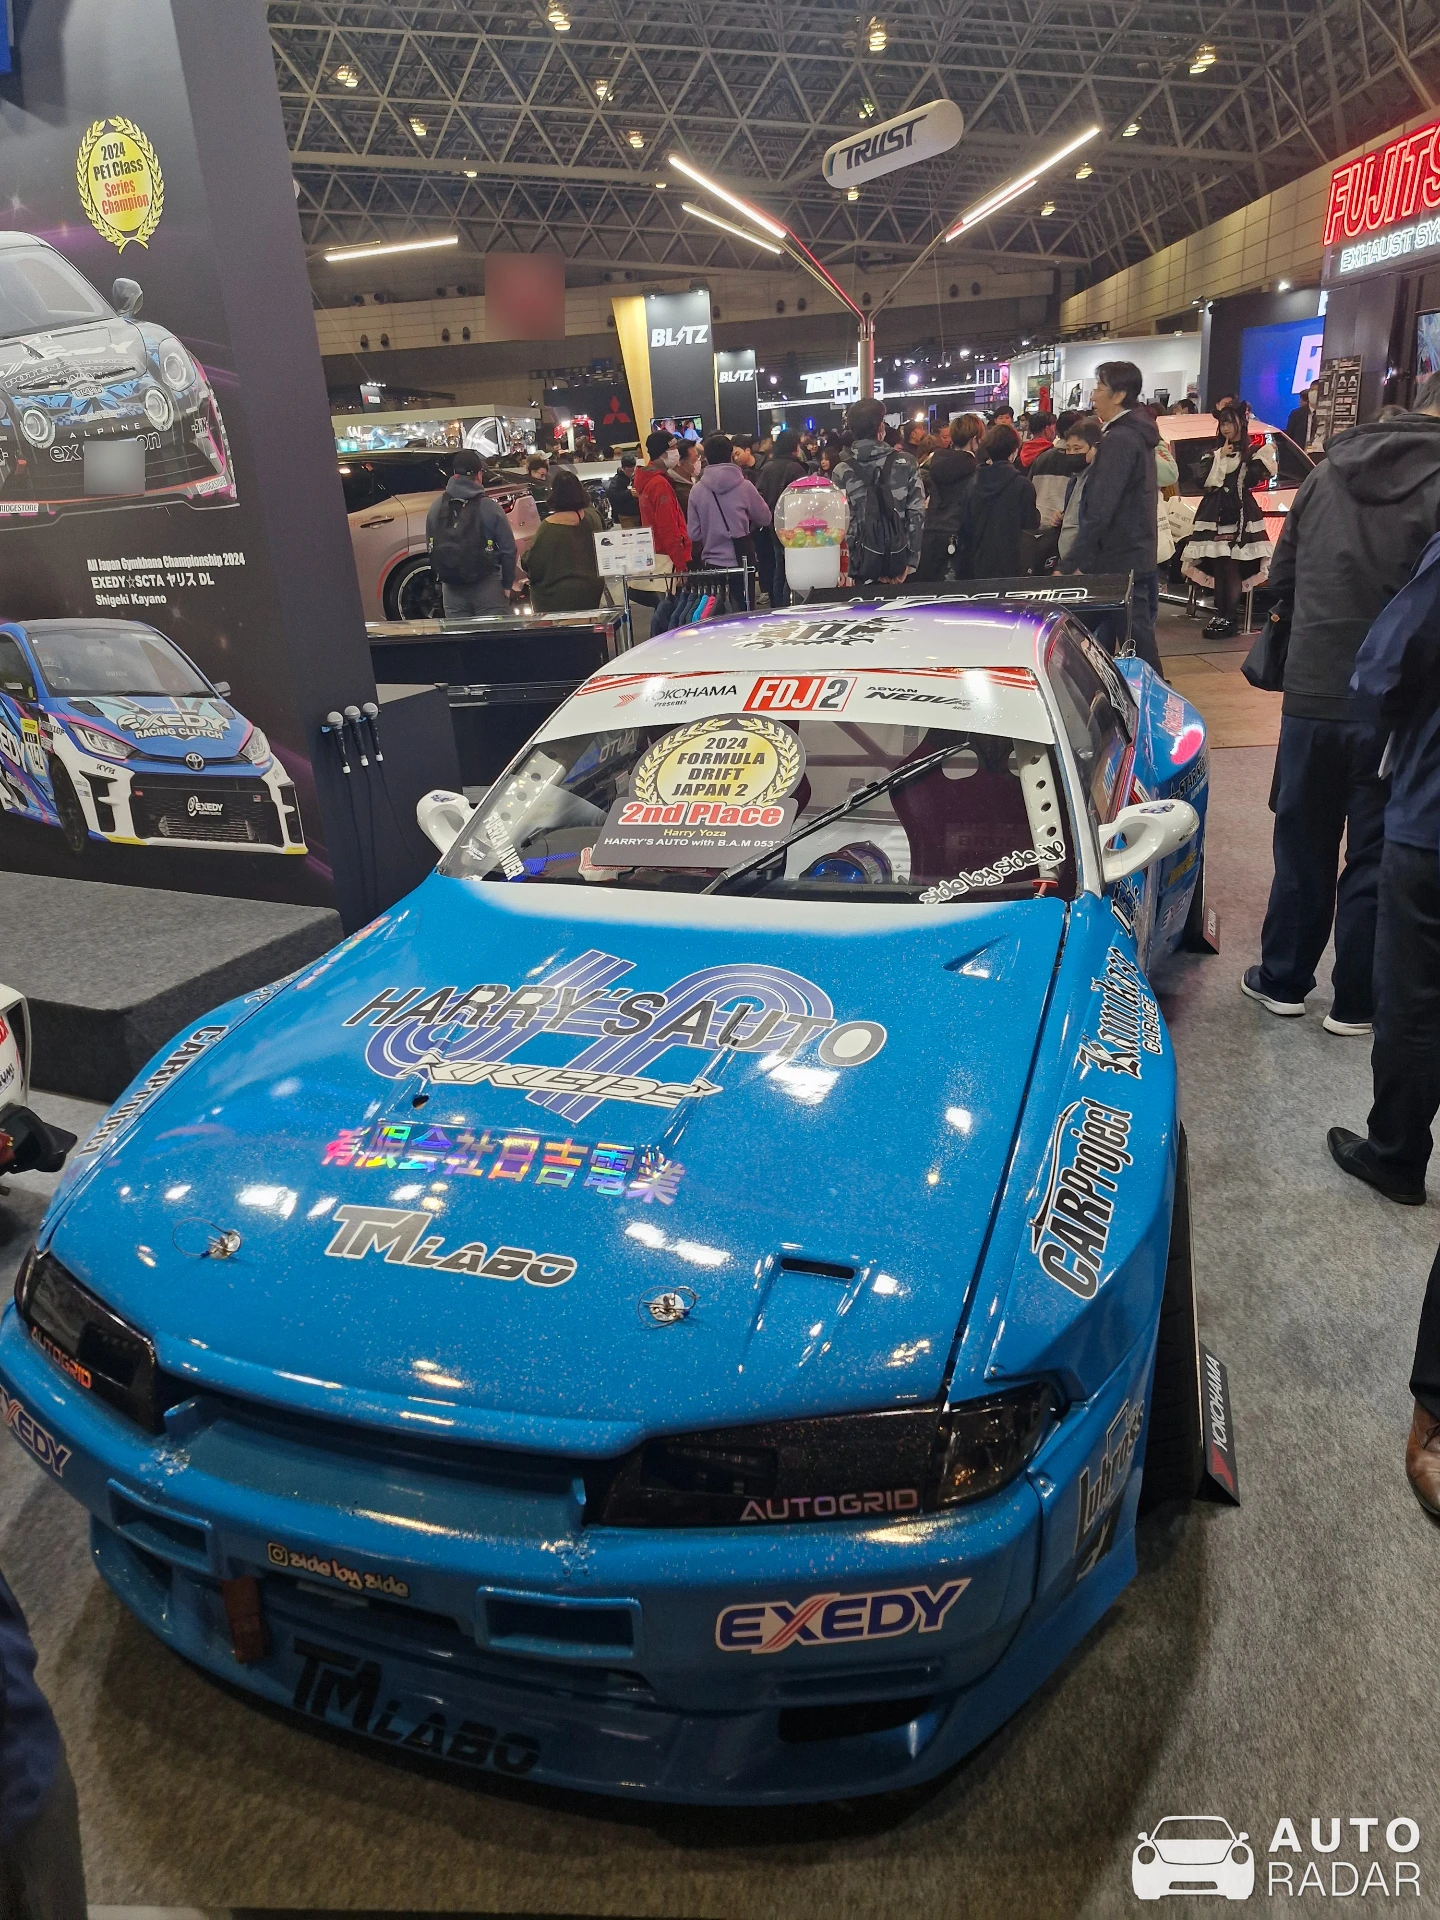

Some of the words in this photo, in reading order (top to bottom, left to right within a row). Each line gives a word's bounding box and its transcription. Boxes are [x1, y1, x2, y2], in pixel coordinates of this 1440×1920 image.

[839, 114, 928, 168] TRUST
[101, 142, 126, 161] 2024
[93, 164, 112, 181] PE1
[112, 159, 144, 177] Class
[104, 180, 136, 198] Series
[101, 194, 149, 215] Champion
[1340, 227, 1416, 273] EXHAUST
[651, 325, 708, 348] BLITZ
[719, 369, 754, 383] BLITZ
[70, 422, 141, 438] ALPINE
[87, 559, 98, 571] All
[99, 558, 121, 571] Japan
[121, 557, 163, 570] Gymkhana
[163, 554, 223, 568] Championship
[223, 552, 245, 566] 2024
[166, 572, 197, 587] ヤリス
[198, 572, 215, 586] DL
[95, 594, 130, 607] Shigeki
[131, 593, 167, 606] Kayano
[654, 700, 688, 708] Presents
[117, 713, 228, 732] EXEDY
[135, 727, 179, 739] RACING
[179, 727, 224, 740] CLUTCH
[704, 737, 749, 750] 2024
[677, 752, 766, 765] FORMULA
[688, 767, 745, 780] DRIFT
[672, 783, 732, 797] JAPAN
[735, 783, 749, 797] 2
[195, 801, 223, 812] EXEDY
[619, 802, 688, 825] 2nd
[687, 802, 784, 827] Place
[483, 811, 511, 850] FUERZA
[663, 828, 696, 838] Harry
[700, 829, 727, 838] Yoza
[604, 838, 654, 846] HARRY'S
[658, 838, 689, 846] AUTO
[692, 839, 713, 847] with
[717, 839, 751, 848] B.A.M
[496, 844, 525, 881] JAVIER
[919, 878, 970, 905] side
[959, 867, 1004, 886] by
[1142, 992, 1163, 1055] GARAGE
[321, 1122, 687, 1205] 有限会社日吉電業
[31, 1326, 92, 1389] AUTOGRID
[1206, 1354, 1229, 1452] YOKOHAMA
[0, 1384, 72, 1478] XEDY
[740, 1488, 919, 1523] AUTOGRID
[289, 1551, 332, 1577] side
[331, 1559, 363, 1591] by
[363, 1572, 409, 1598] side
[715, 1578, 972, 1655] EXEDY
